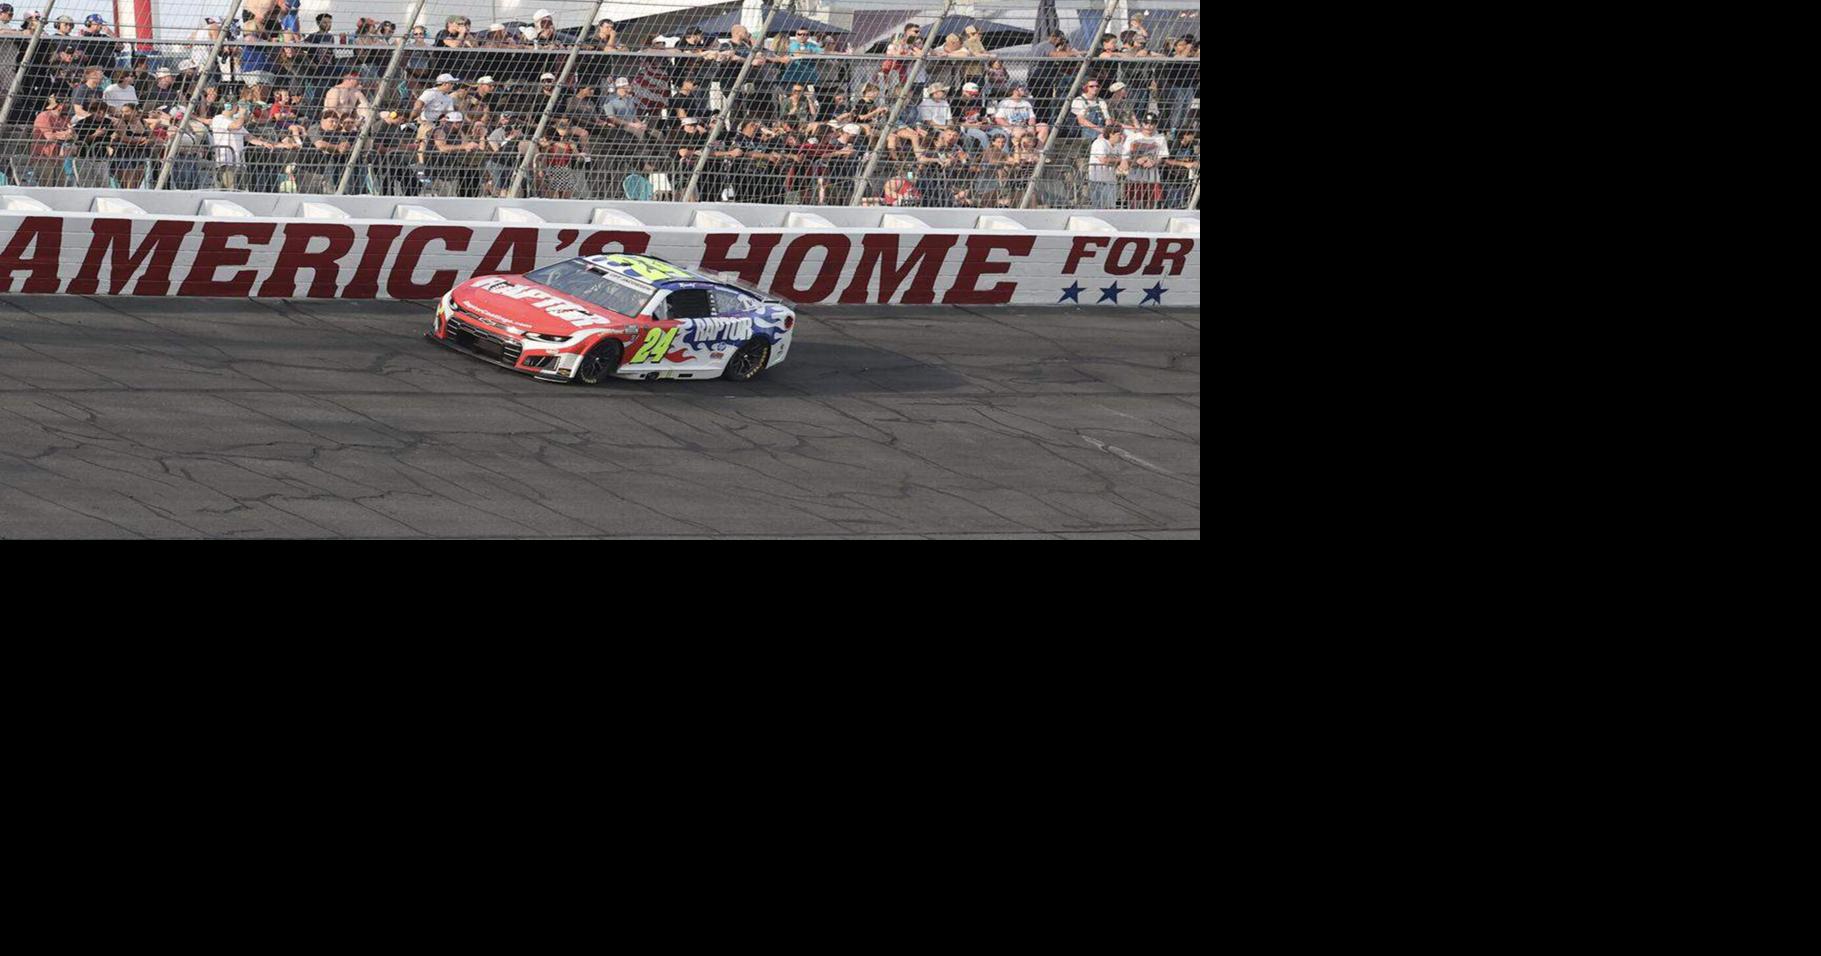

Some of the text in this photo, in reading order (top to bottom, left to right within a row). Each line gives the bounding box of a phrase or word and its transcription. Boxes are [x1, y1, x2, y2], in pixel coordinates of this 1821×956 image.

[699, 233, 1037, 306] HOME
[1062, 236, 1194, 277] FOR
[470, 275, 611, 327] RAPTOR
[629, 327, 680, 364] 24
[693, 316, 753, 342] RAPTOR
